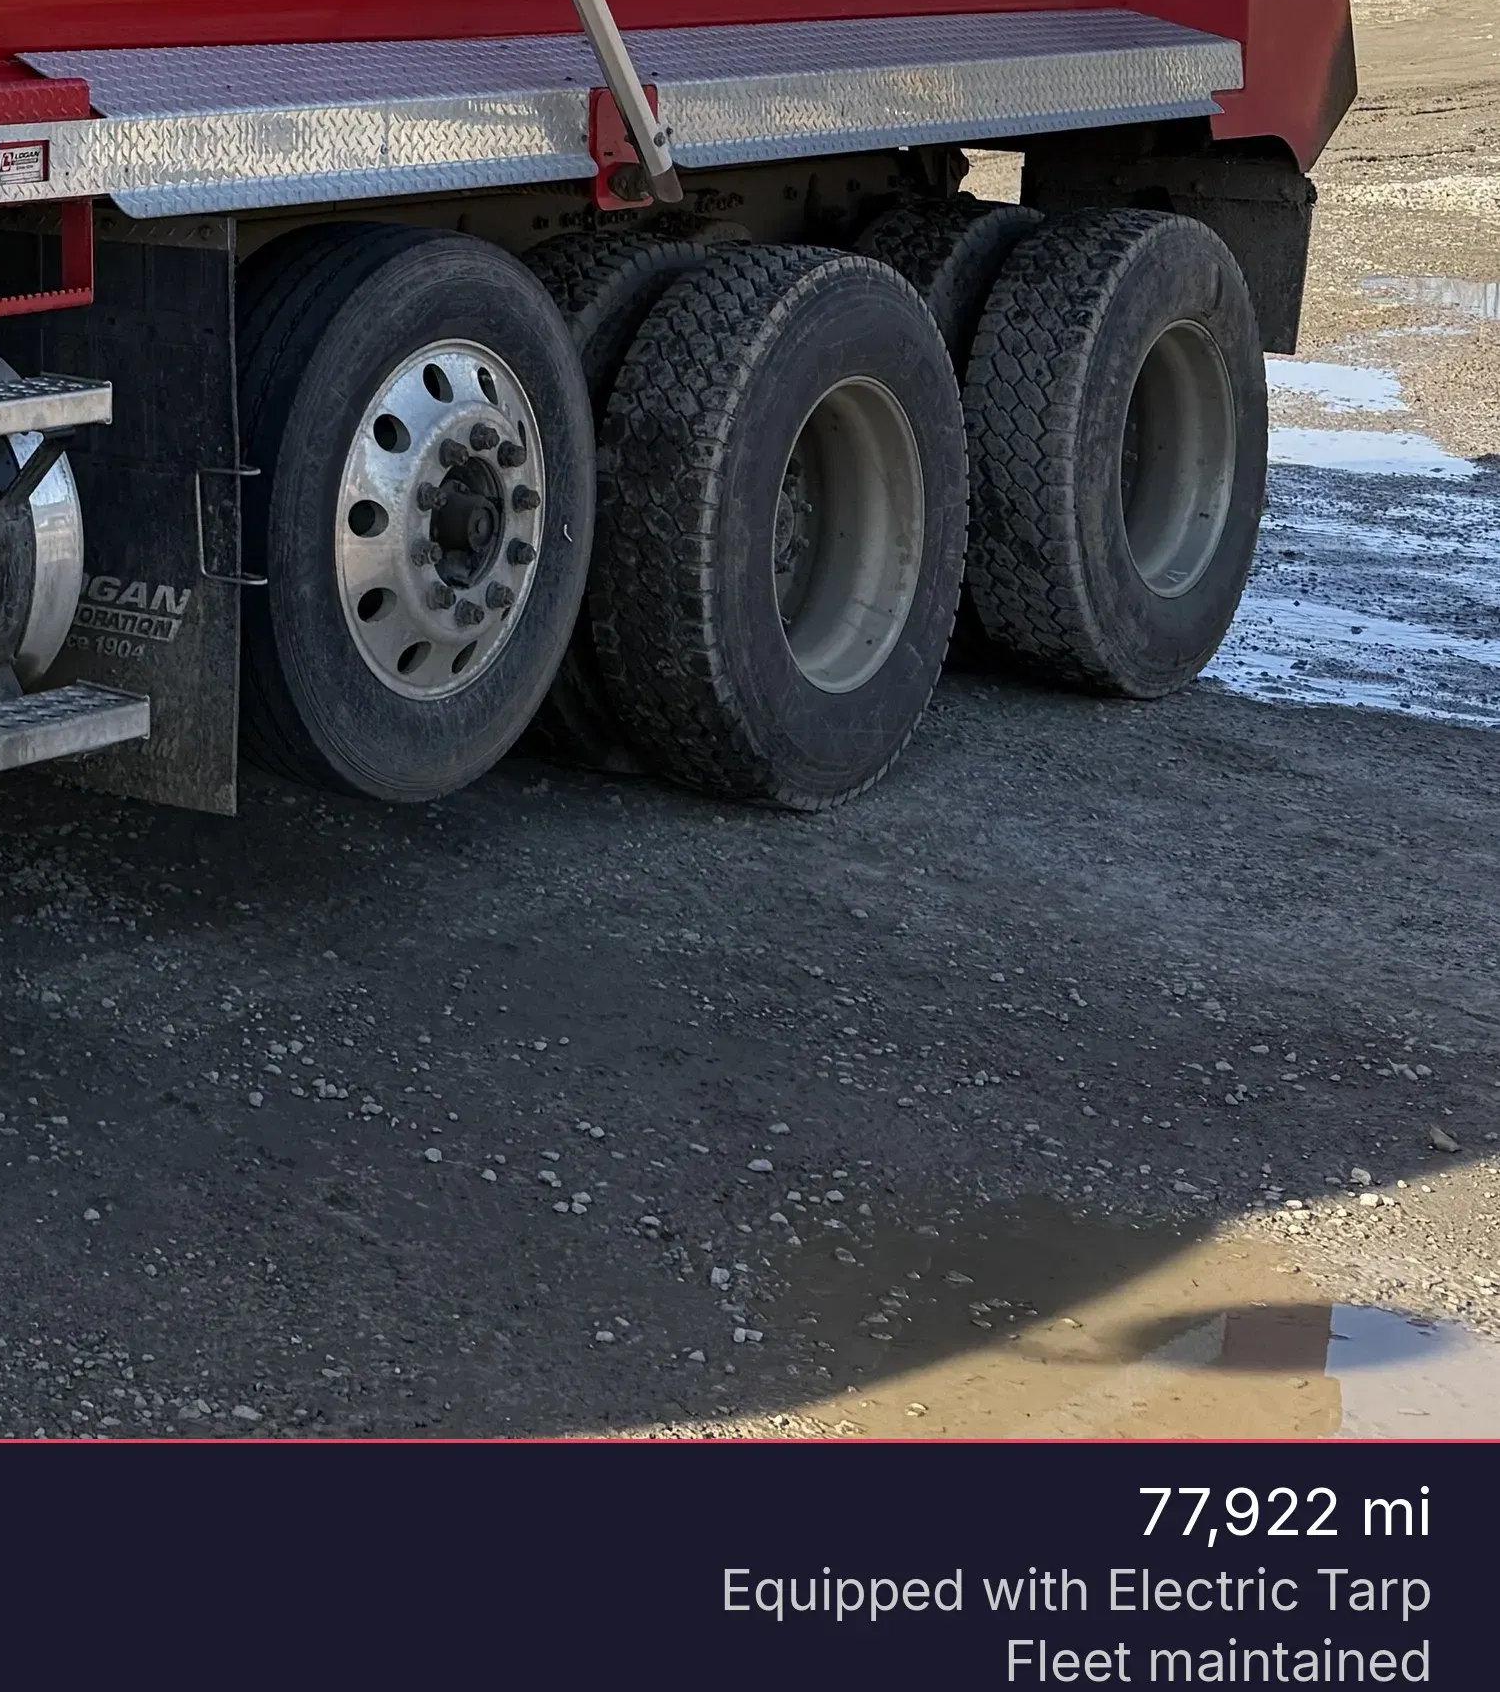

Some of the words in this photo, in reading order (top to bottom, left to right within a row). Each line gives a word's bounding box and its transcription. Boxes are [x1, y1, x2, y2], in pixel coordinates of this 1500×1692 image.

[15, 151, 41, 159] LOGAN
[81, 572, 192, 615] GAN
[78, 607, 173, 639] ORATION
[96, 635, 146, 660] 1904
